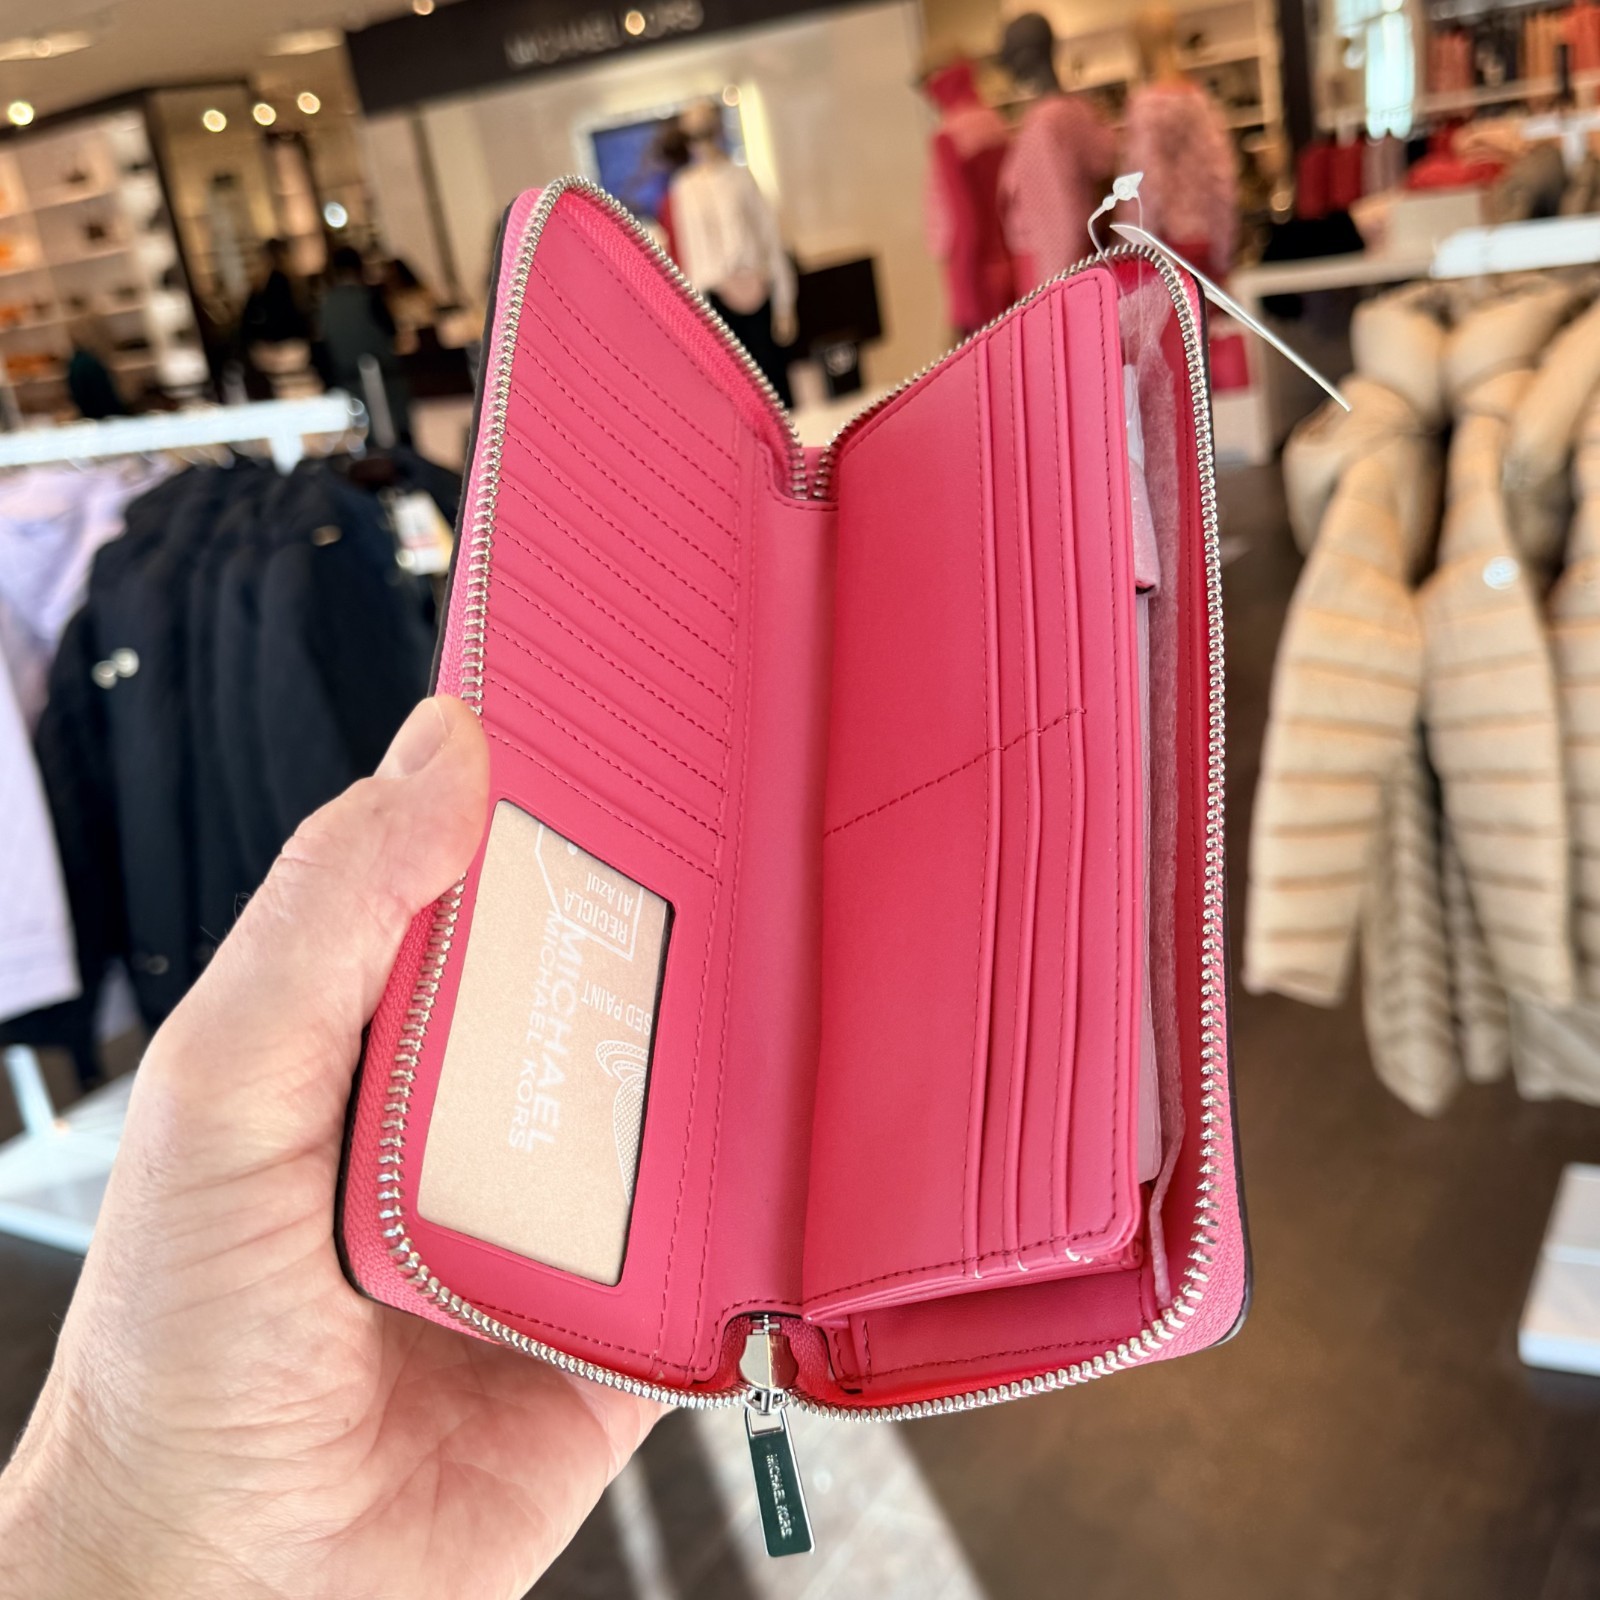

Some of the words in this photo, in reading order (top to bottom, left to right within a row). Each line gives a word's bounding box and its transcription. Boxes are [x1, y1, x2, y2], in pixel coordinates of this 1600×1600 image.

[563, 887, 629, 945] RECICLA
[525, 909, 561, 1046] MICHAEL
[580, 979, 624, 1021] PAINT
[524, 929, 588, 1152] MICHAEL
[508, 1058, 538, 1149] KORS
[766, 1453, 786, 1505] MICHAEL
[776, 1504, 793, 1539] KORS
